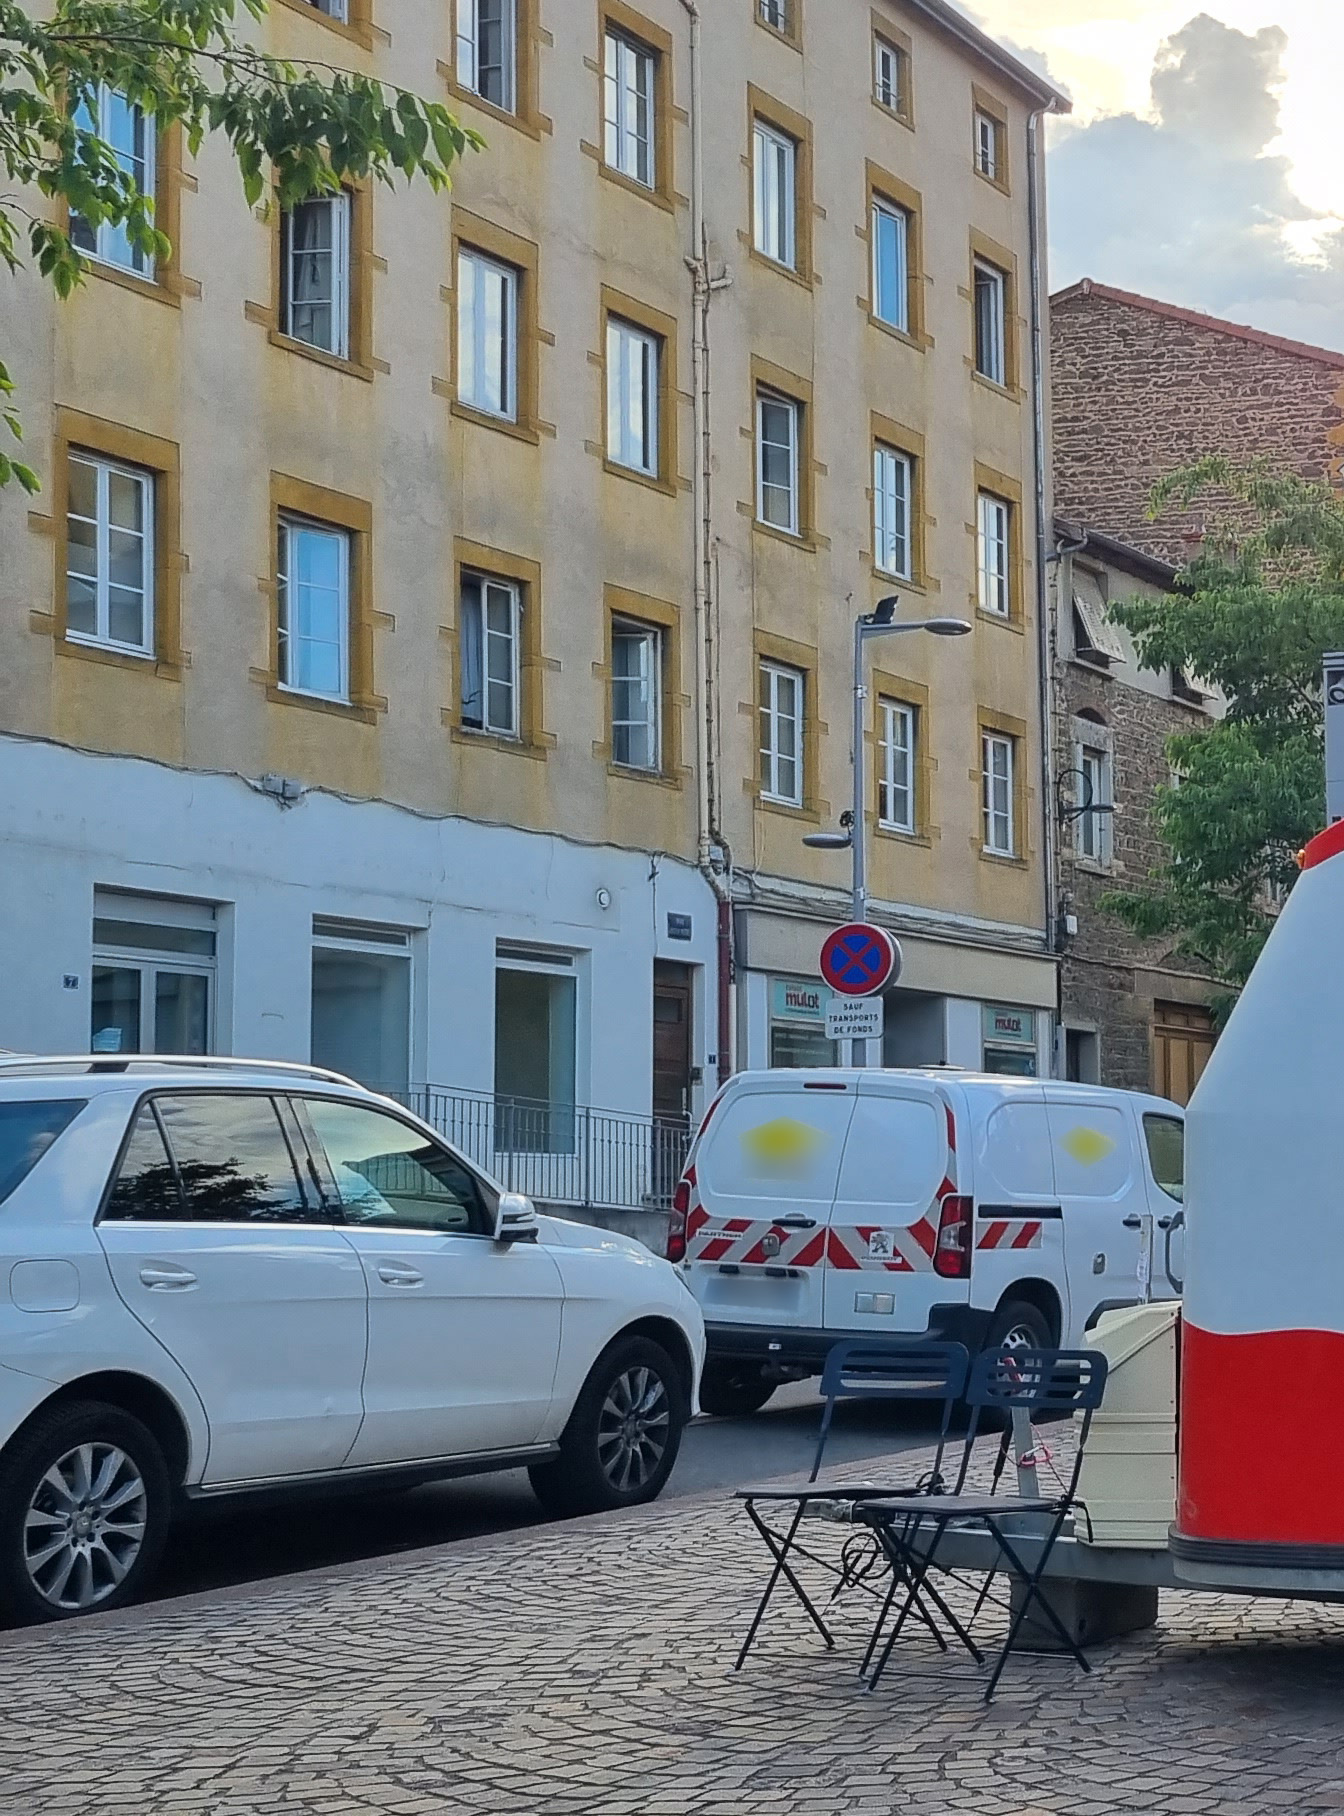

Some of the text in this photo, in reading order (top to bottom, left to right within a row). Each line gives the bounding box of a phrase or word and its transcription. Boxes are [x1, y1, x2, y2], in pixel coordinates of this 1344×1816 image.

[829, 1013, 878, 1022] TRANSPORTS
[834, 1025, 873, 1034] DE FONDS
